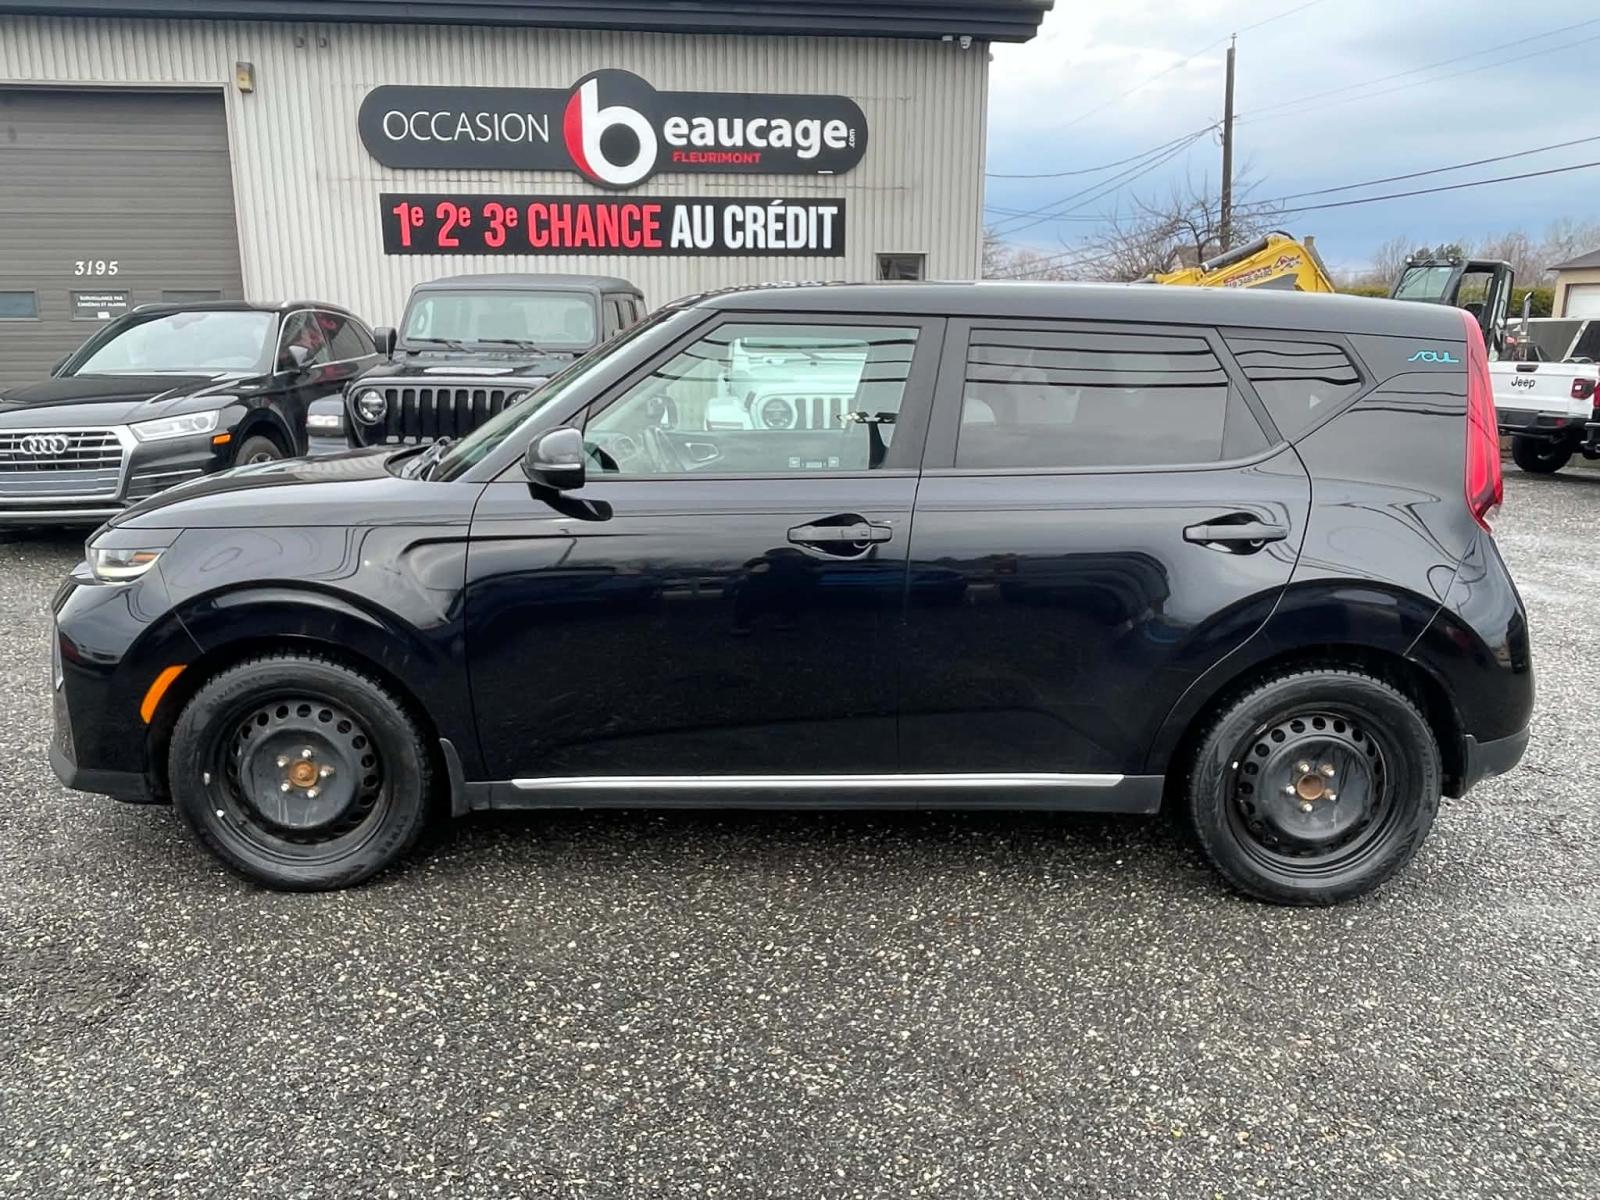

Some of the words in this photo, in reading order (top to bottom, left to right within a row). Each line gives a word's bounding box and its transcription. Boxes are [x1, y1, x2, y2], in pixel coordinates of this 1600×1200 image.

[382, 110, 549, 143] OCCASION
[672, 151, 762, 163] FLEURIMONT
[527, 203, 662, 248] CHANCE
[670, 204, 714, 249] AU
[723, 198, 838, 250] CRÉDIT
[74, 260, 119, 276] 3195
[1511, 376, 1536, 389] Jeep
